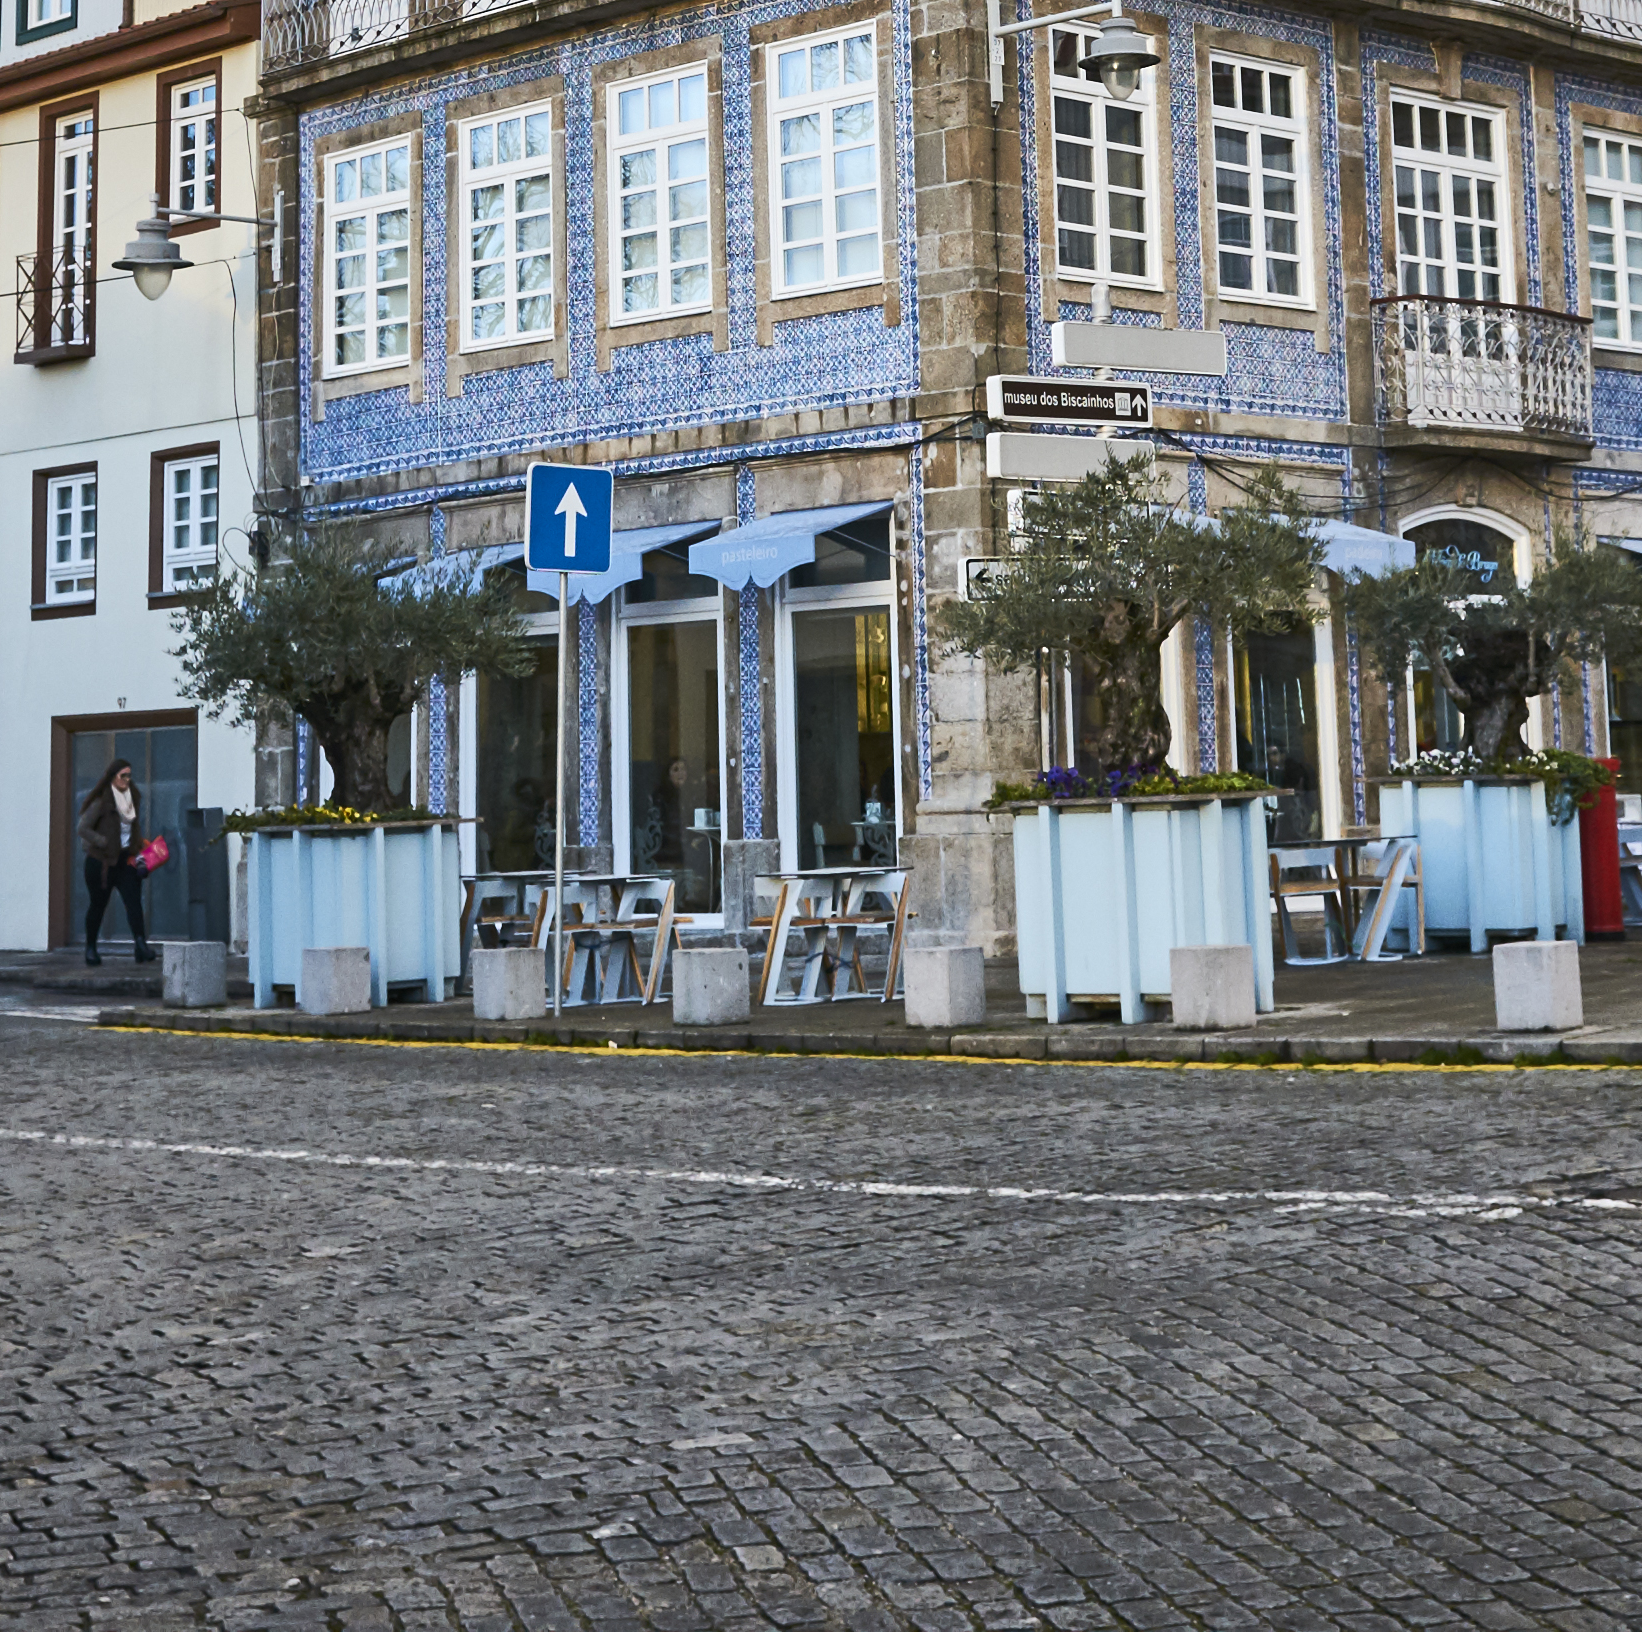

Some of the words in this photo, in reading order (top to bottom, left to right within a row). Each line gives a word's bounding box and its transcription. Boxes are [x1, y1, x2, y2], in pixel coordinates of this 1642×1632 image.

[1004, 392, 1038, 405] museu
[1040, 391, 1059, 407] dos
[721, 544, 778, 568] pasteleiro
[117, 697, 127, 709] 97
